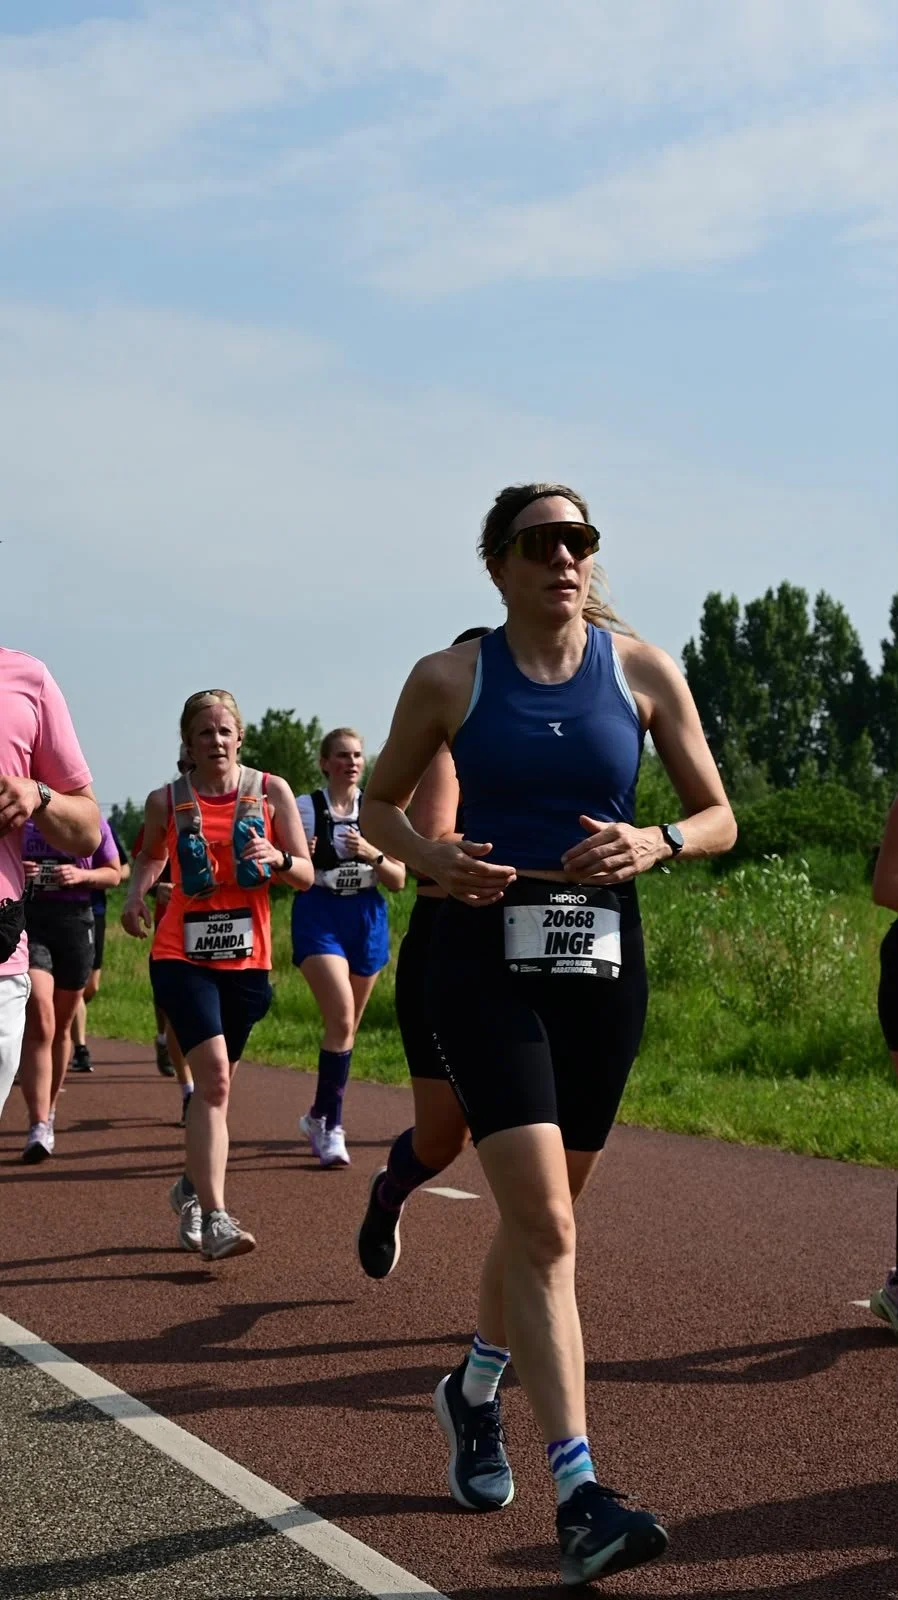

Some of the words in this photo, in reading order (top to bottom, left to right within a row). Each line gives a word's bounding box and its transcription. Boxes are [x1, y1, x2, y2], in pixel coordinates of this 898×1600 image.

[336, 878, 362, 887] ELLEN
[542, 909, 595, 929] 20668
[206, 922, 233, 934] 29419
[194, 933, 244, 950] AMANDA
[544, 932, 595, 955] INGE
